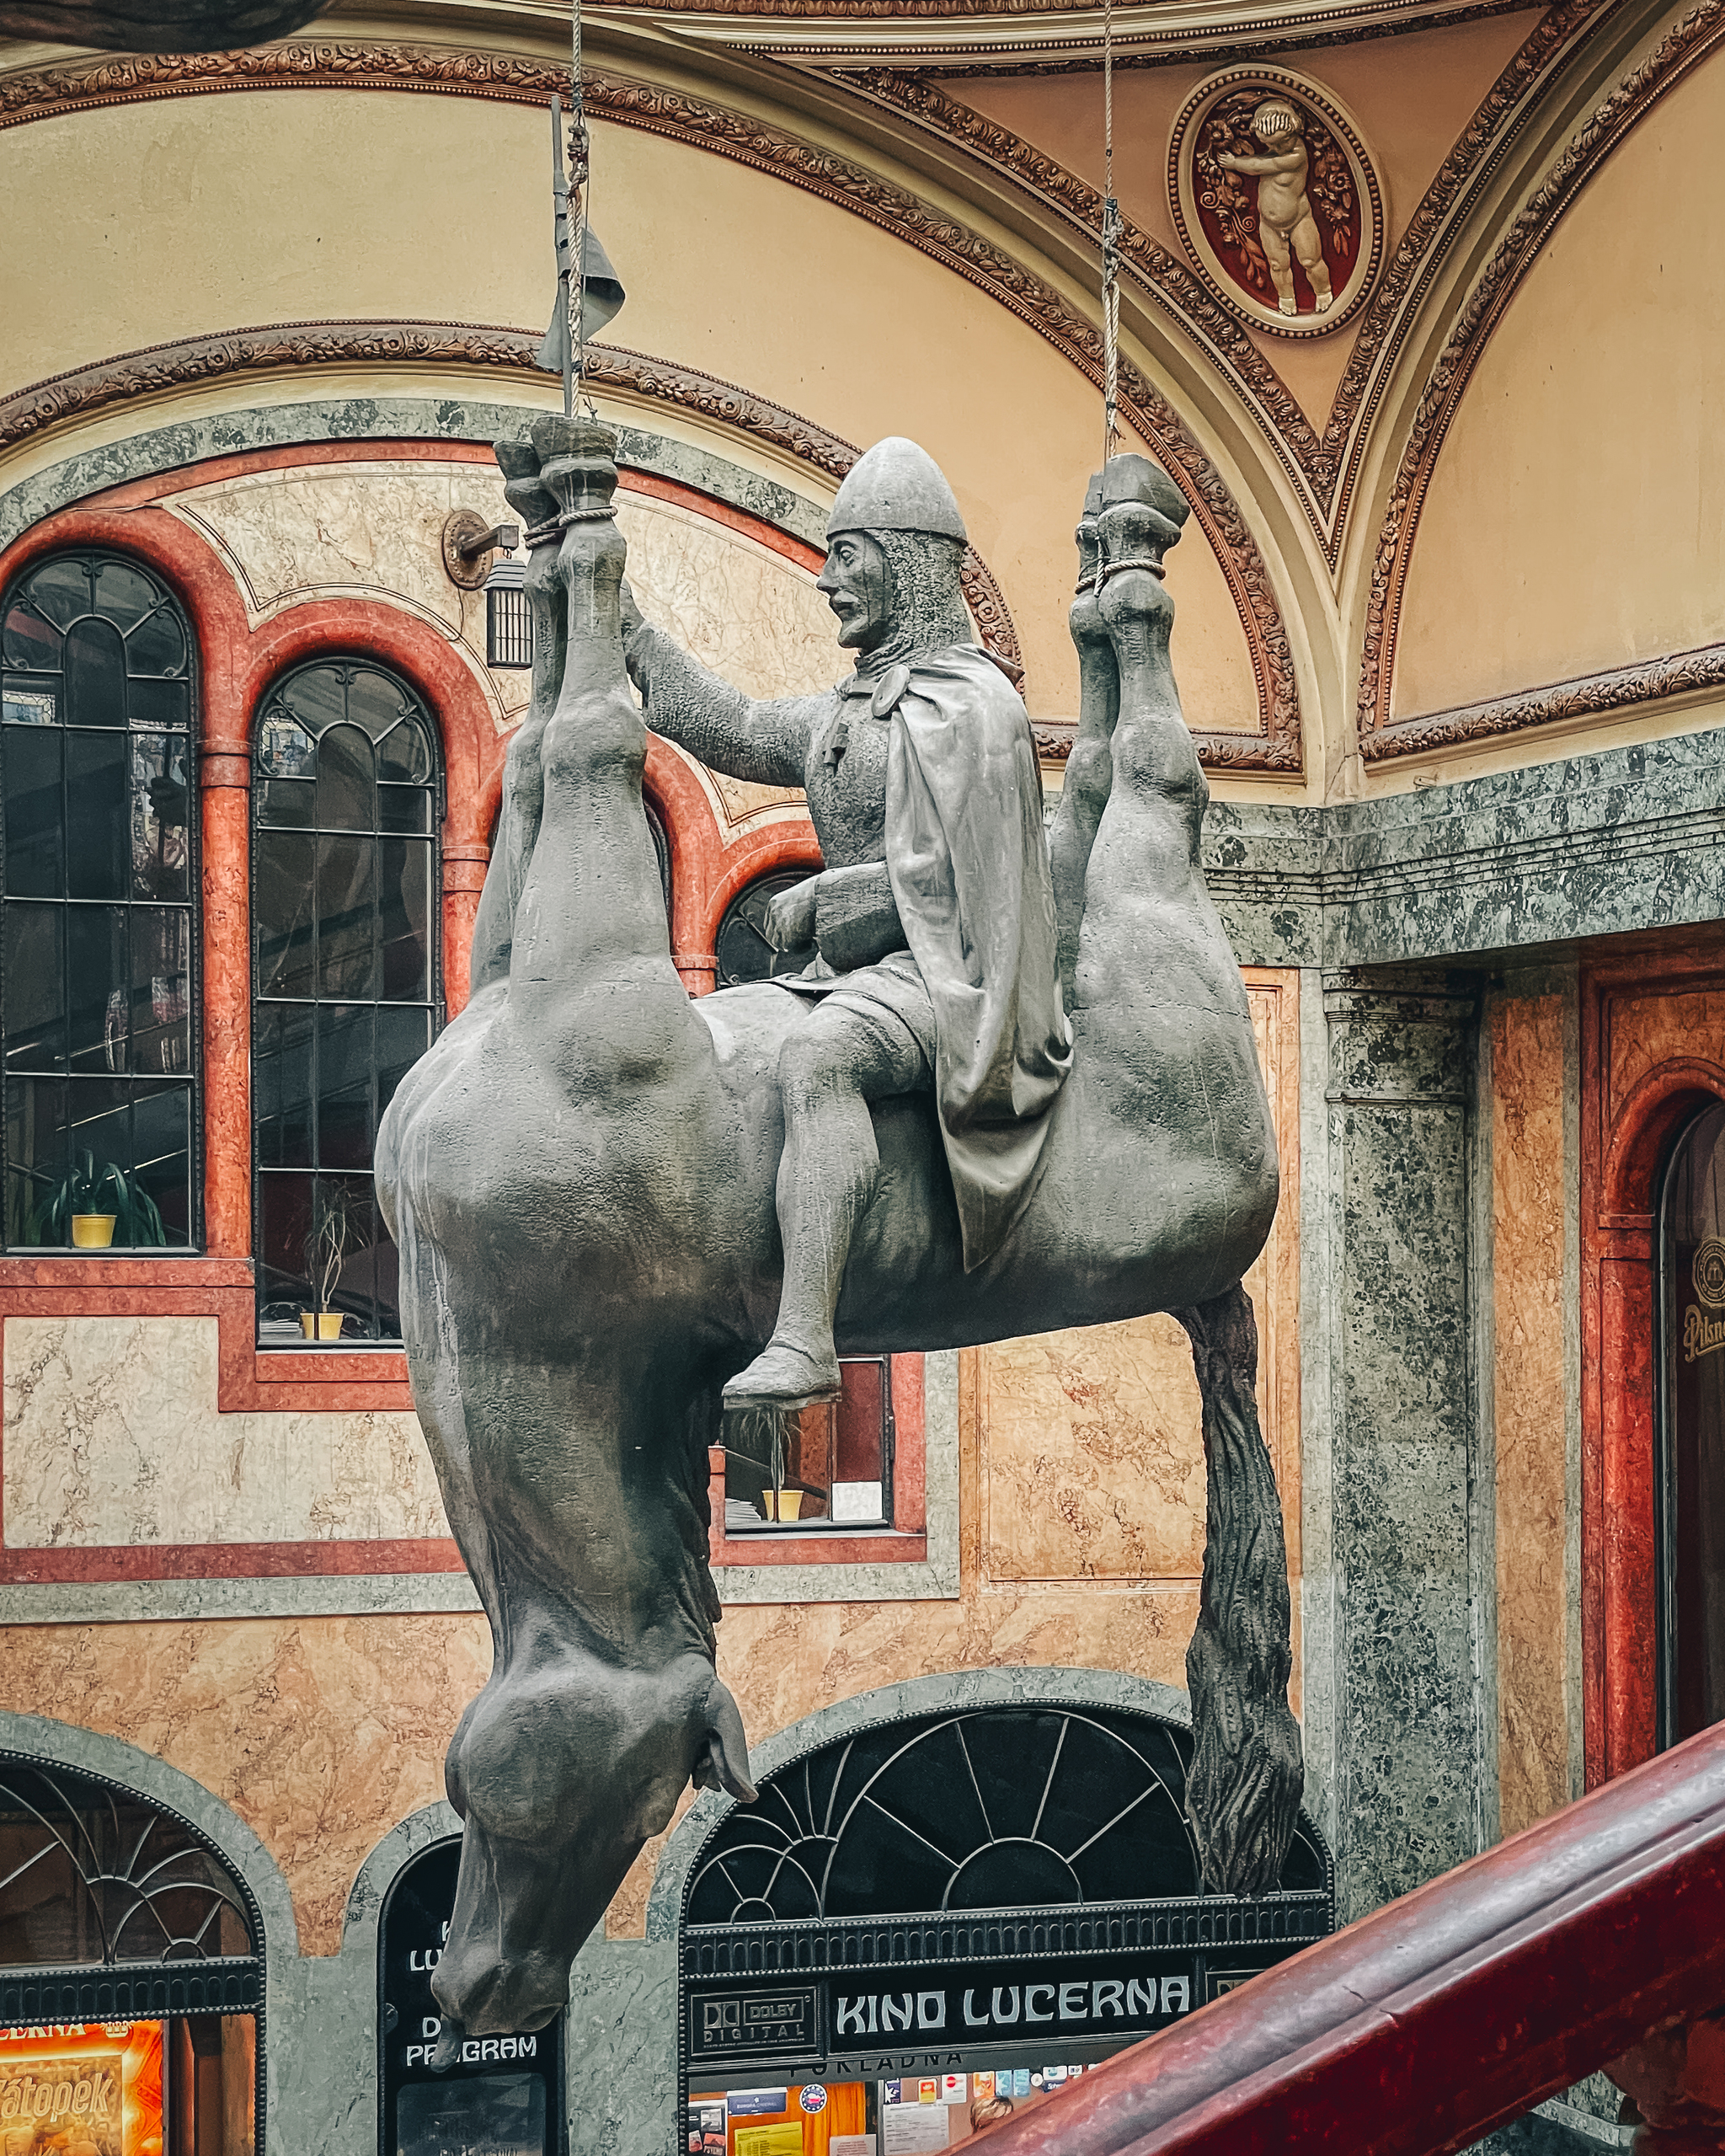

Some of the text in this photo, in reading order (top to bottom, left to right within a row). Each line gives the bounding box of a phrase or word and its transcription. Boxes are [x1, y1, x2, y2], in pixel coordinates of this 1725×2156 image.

[750, 2004, 797, 2020] DOLBY
[836, 1976, 1189, 2035] KINO LUCERNA
[703, 2024, 804, 2043] DIGITAL
[406, 2036, 537, 2067] PRGRAM
